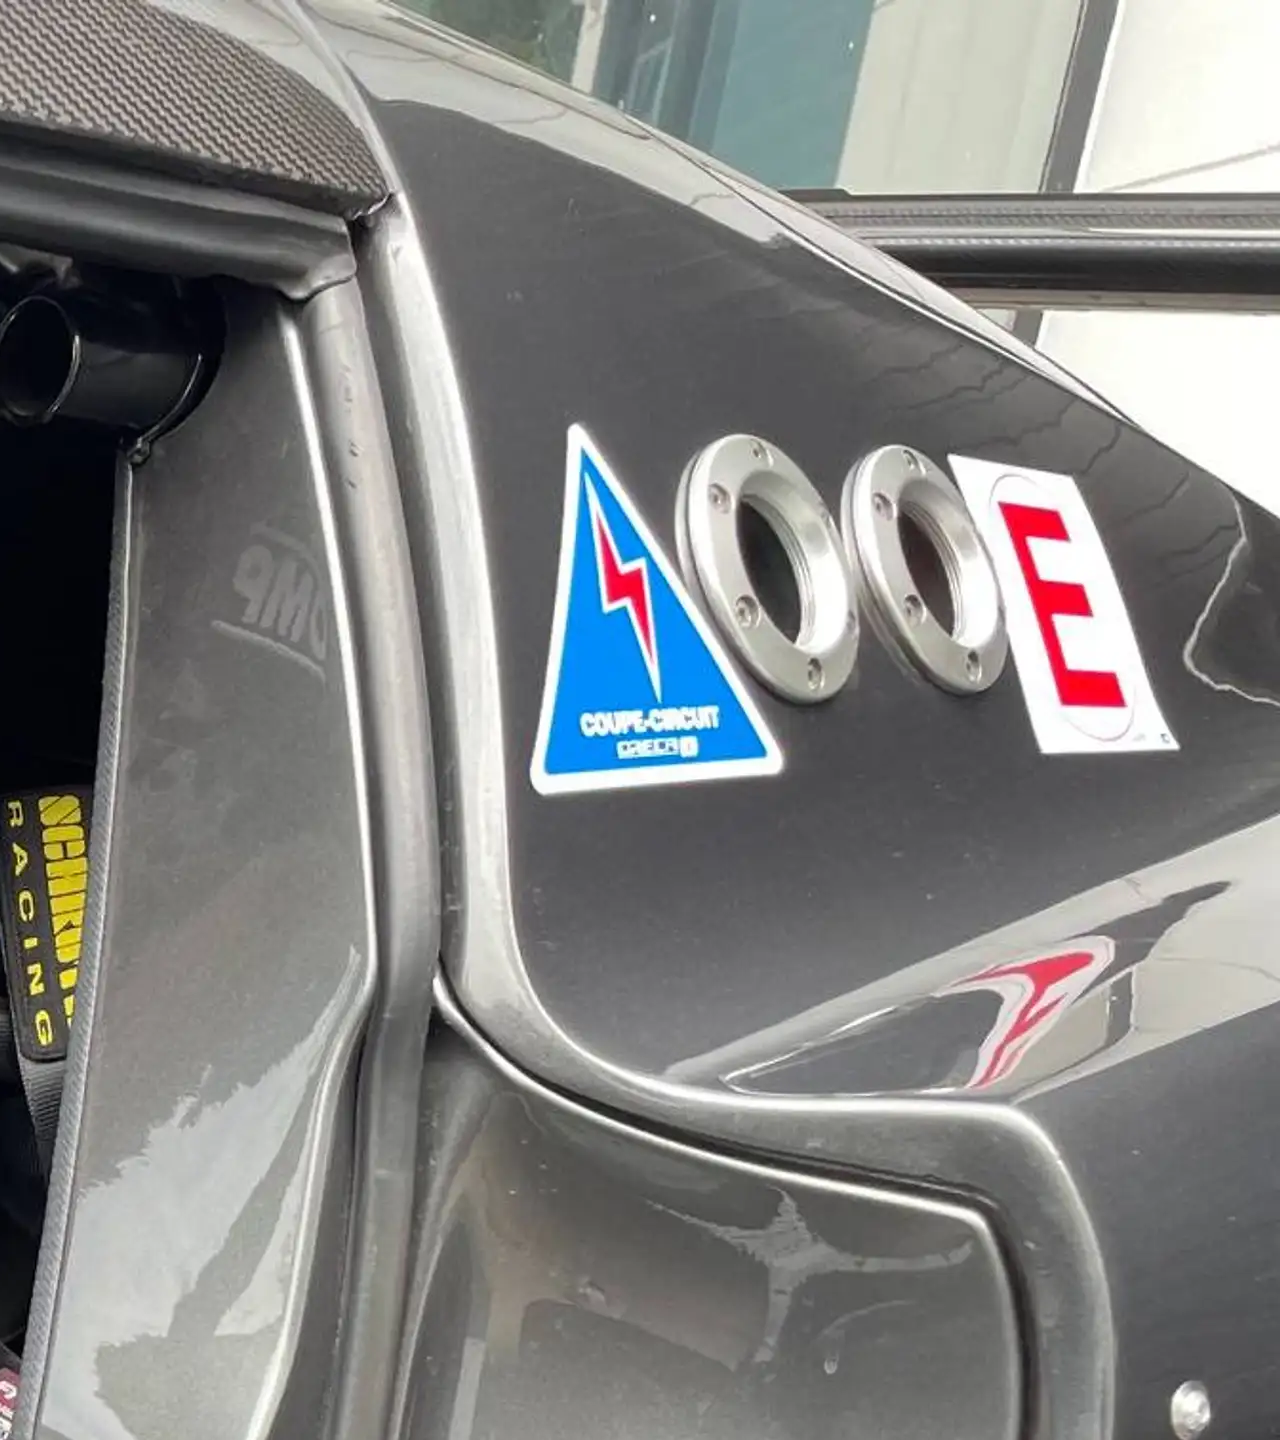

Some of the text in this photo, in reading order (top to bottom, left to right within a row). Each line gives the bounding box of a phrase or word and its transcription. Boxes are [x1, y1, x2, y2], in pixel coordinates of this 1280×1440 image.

[998, 502, 1128, 708] E
[580, 705, 719, 737] COUPE-CIRCUIT
[8, 800, 54, 1046] RACING
[39, 795, 88, 1032] SCHRO
